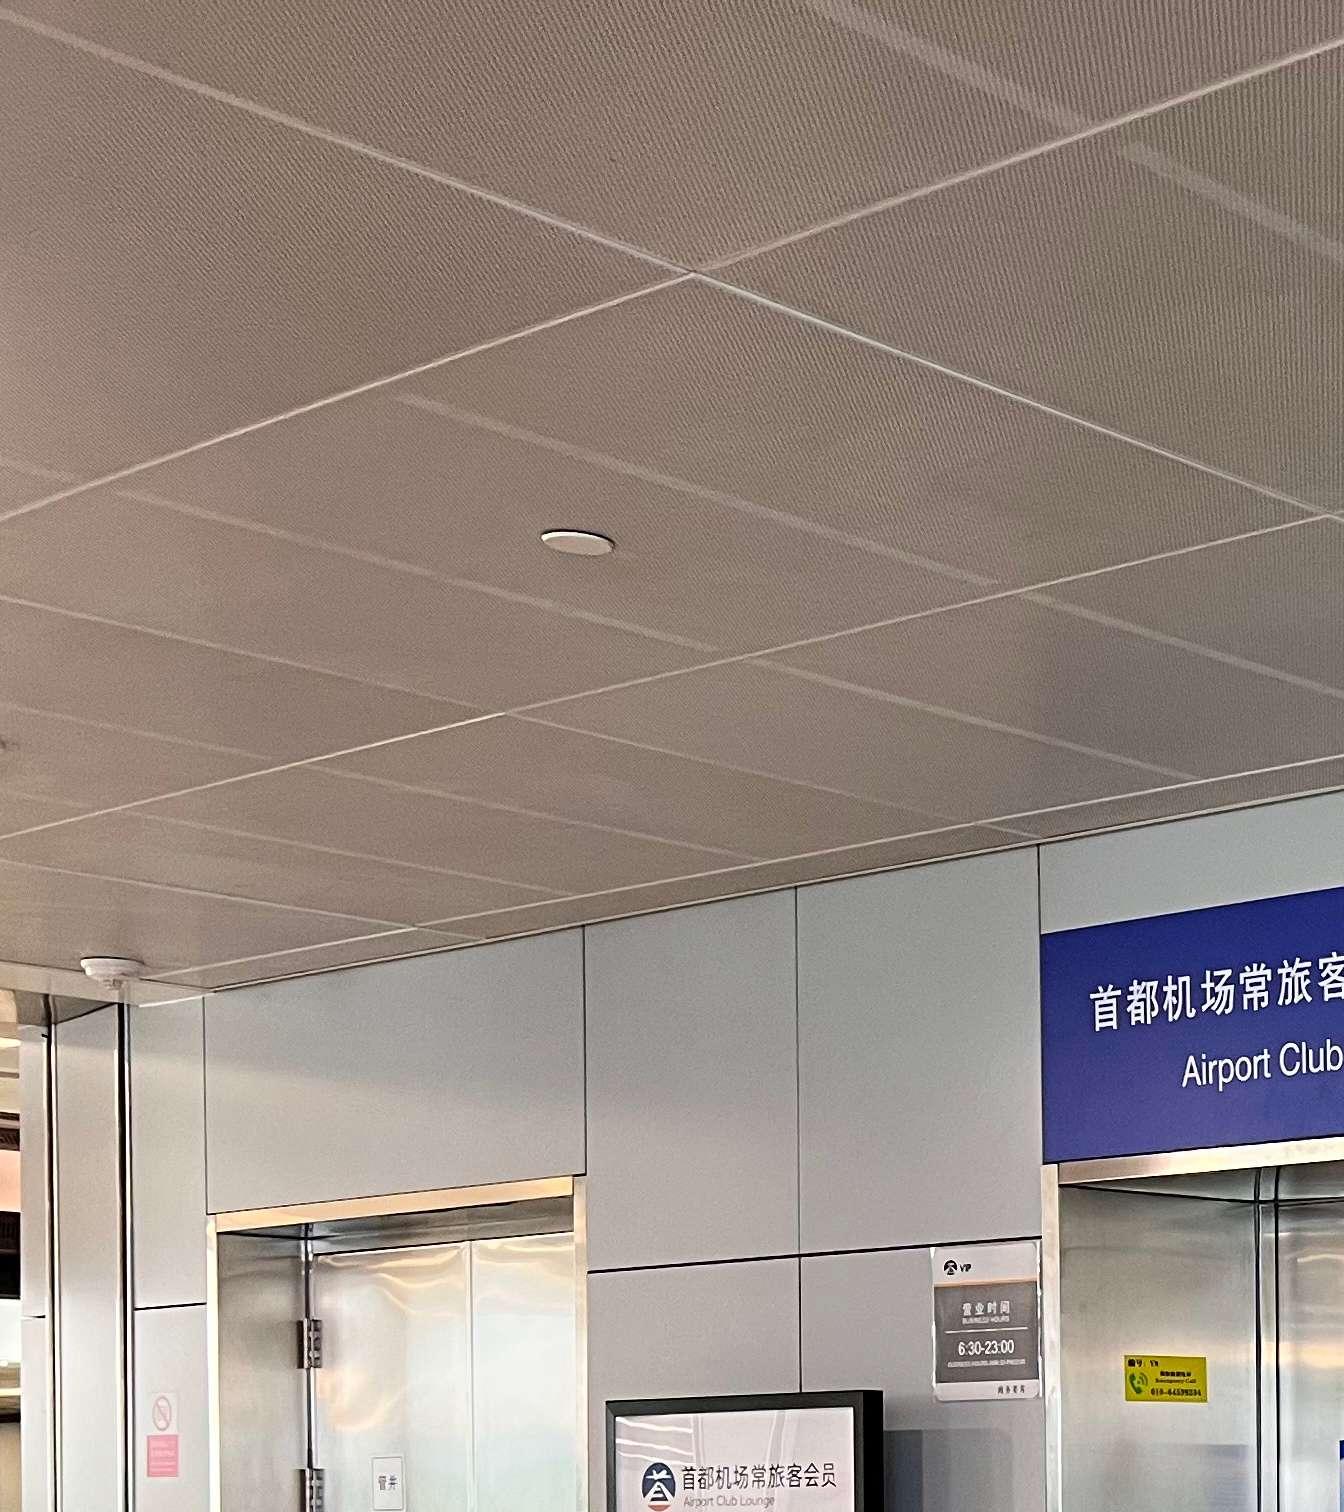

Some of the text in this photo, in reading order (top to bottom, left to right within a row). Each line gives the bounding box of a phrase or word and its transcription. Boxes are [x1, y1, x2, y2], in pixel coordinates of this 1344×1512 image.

[1181, 1048, 1272, 1091] Airport
[1278, 1038, 1344, 1078] Club
[962, 1300, 1010, 1316] 营业时间
[958, 1339, 1015, 1356] 6:30-23:00
[682, 1462, 837, 1491] 首都机场常旅客会员
[684, 1494, 776, 1509] Airport Club Lounge
